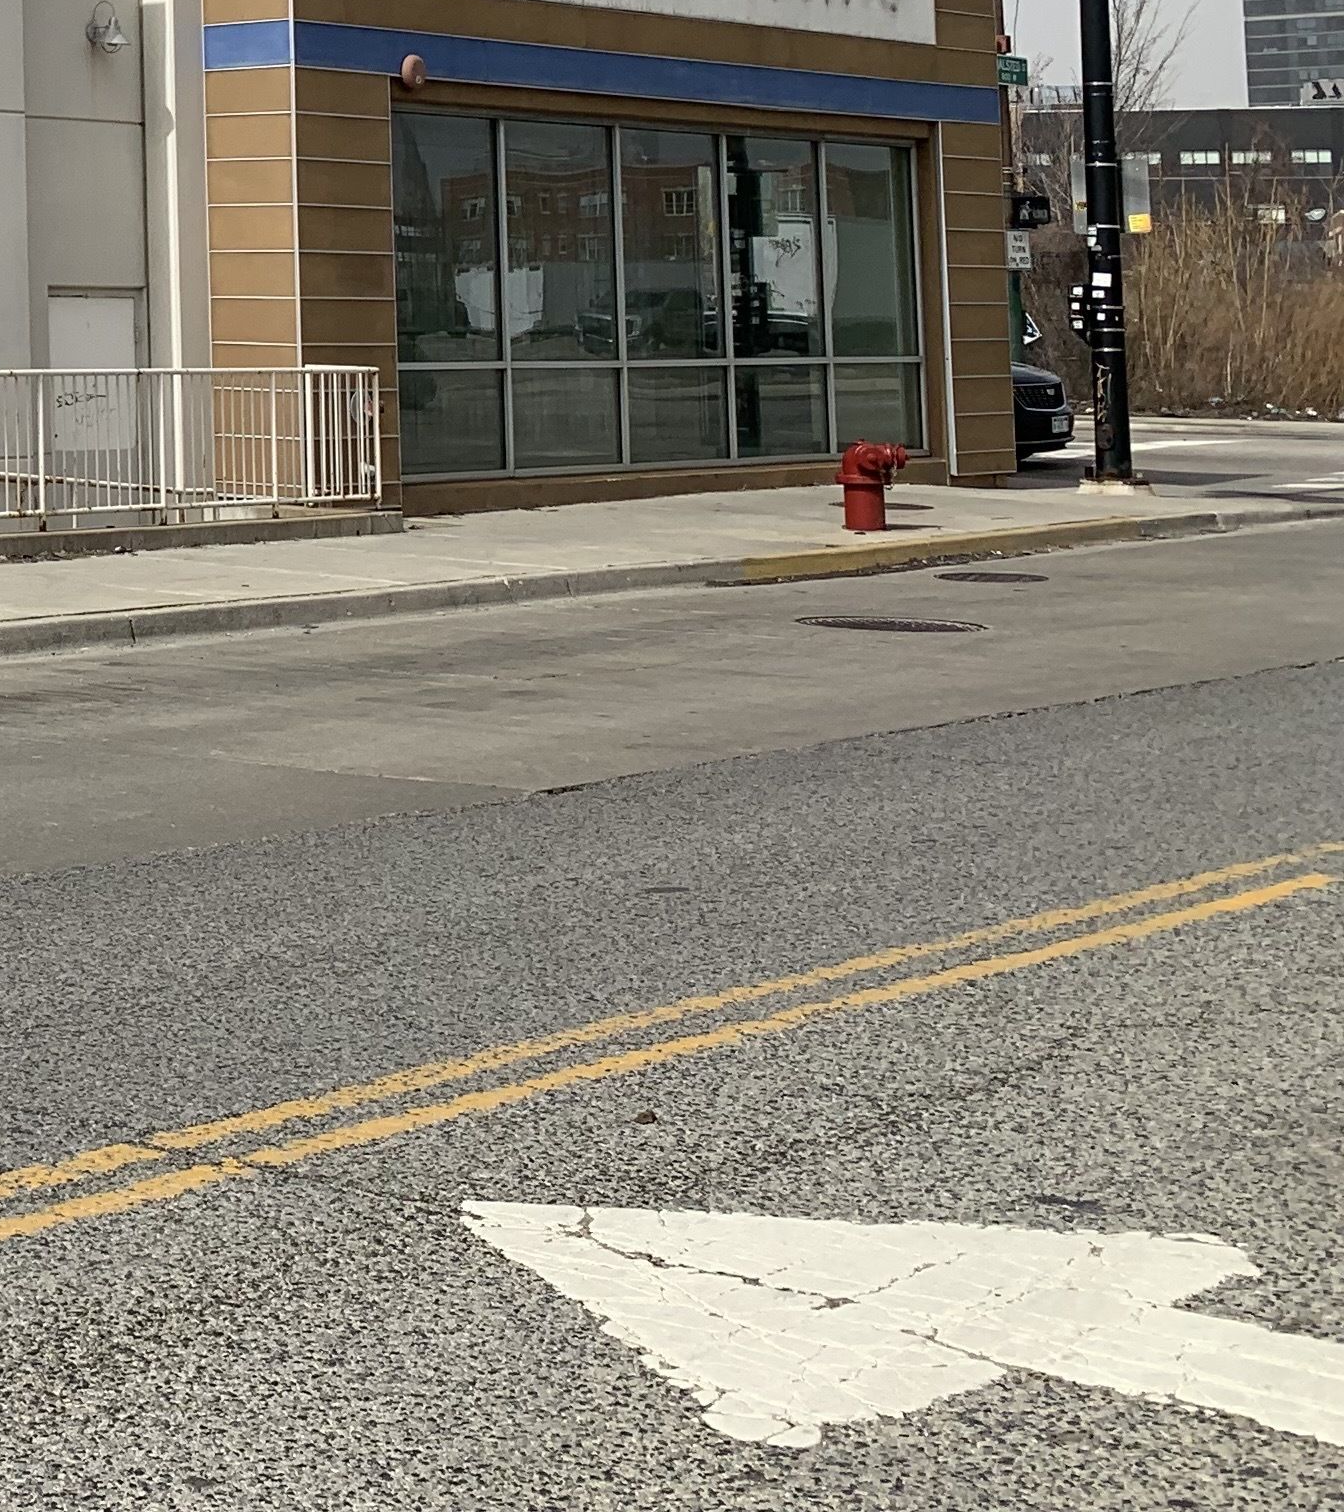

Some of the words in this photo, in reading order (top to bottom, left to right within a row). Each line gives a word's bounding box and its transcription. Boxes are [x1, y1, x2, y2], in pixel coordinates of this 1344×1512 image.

[1013, 234, 1023, 242] NO
[1011, 245, 1026, 253] TURN
[1019, 256, 1029, 264] RED
